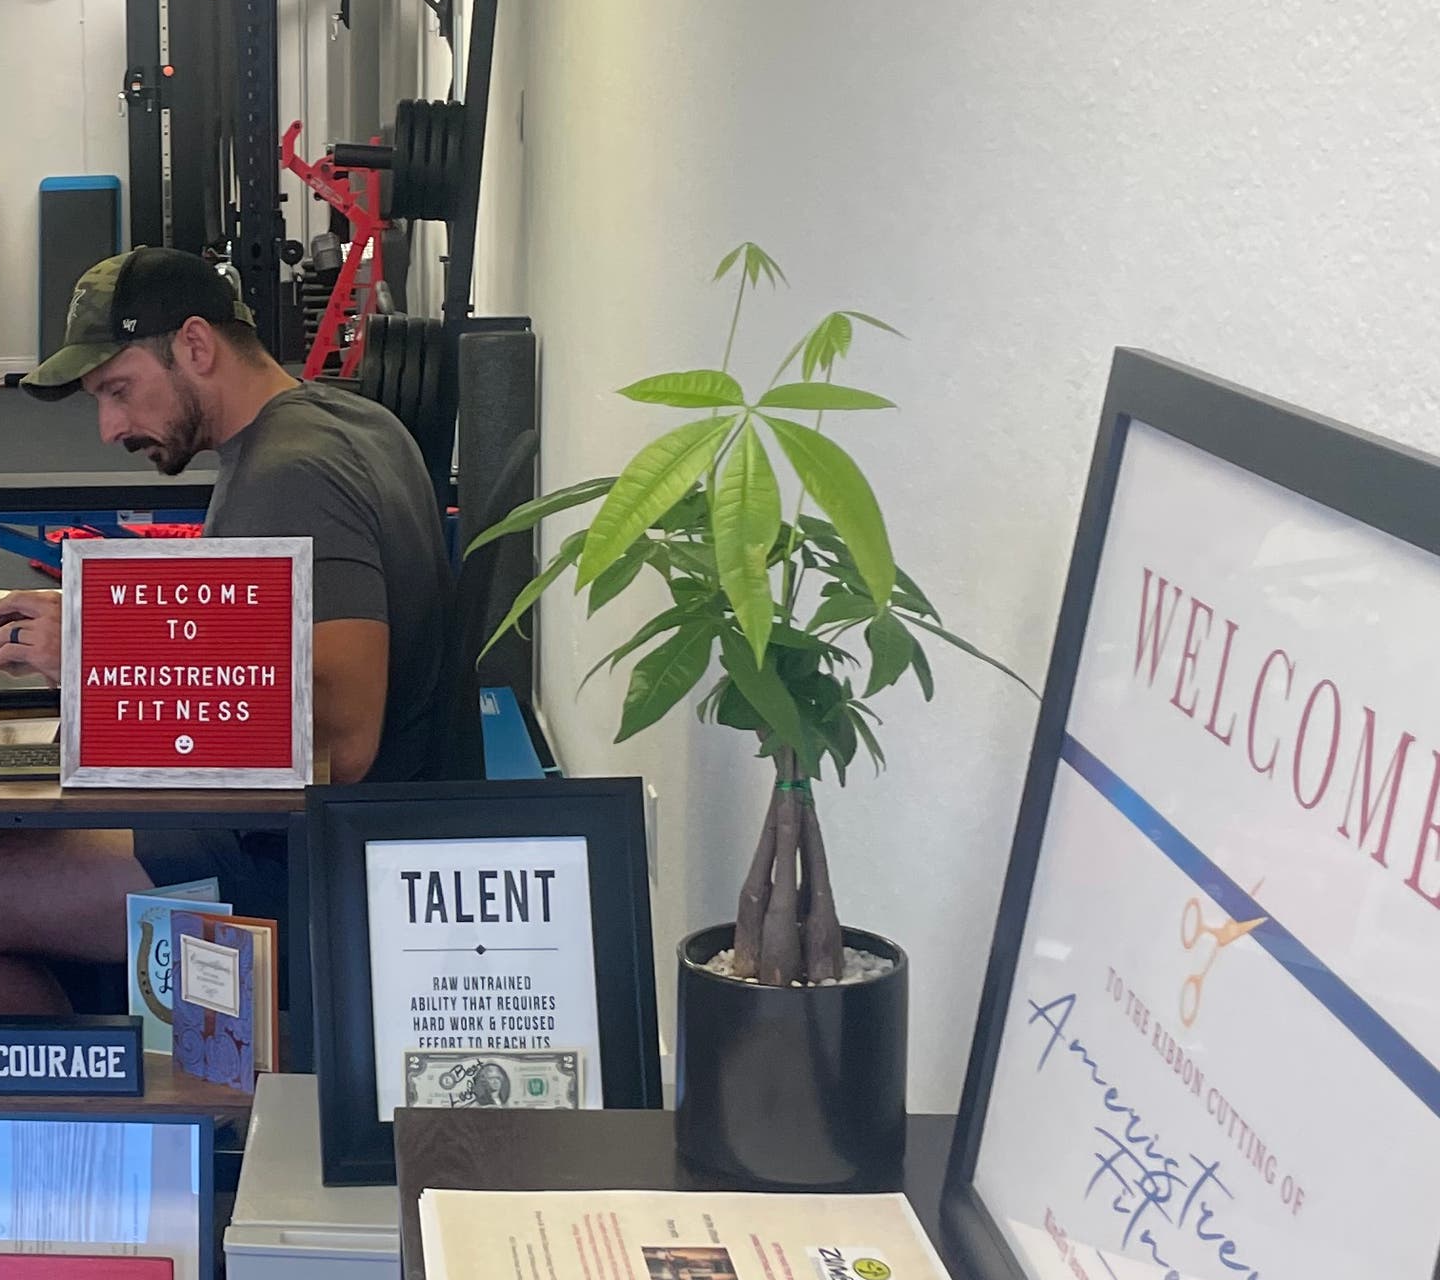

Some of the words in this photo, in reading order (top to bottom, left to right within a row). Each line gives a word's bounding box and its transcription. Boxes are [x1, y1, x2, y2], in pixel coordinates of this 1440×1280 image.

[110, 584, 260, 606] WELCOME
[166, 619, 198, 640] TO
[87, 665, 276, 688] AMERISTRENGTH
[116, 700, 250, 722] FITNESS
[1132, 567, 1440, 910] WELCOME
[400, 869, 556, 924] TALENT
[432, 976, 458, 991] RAW
[463, 976, 532, 991] UNTRAINED
[410, 996, 457, 1011] ABILITY
[462, 996, 492, 1011] THAT
[496, 995, 556, 1011] REQUIRES
[413, 1016, 444, 1032] HARD
[449, 1016, 483, 1031] WORK
[489, 1016, 496, 1031] &
[501, 1015, 555, 1031] FOCUSED
[419, 1037, 464, 1049] EFFORT
[469, 1037, 483, 1049] TO
[488, 1037, 527, 1049] REACH
[532, 1036, 551, 1049] ITS
[1104, 963, 1124, 1008] TO
[1124, 986, 1150, 1039] THE
[1151, 1018, 1204, 1104] RIBBON
[1205, 1080, 1278, 1191] CUTTING
[1279, 1167, 1304, 1223] OF
